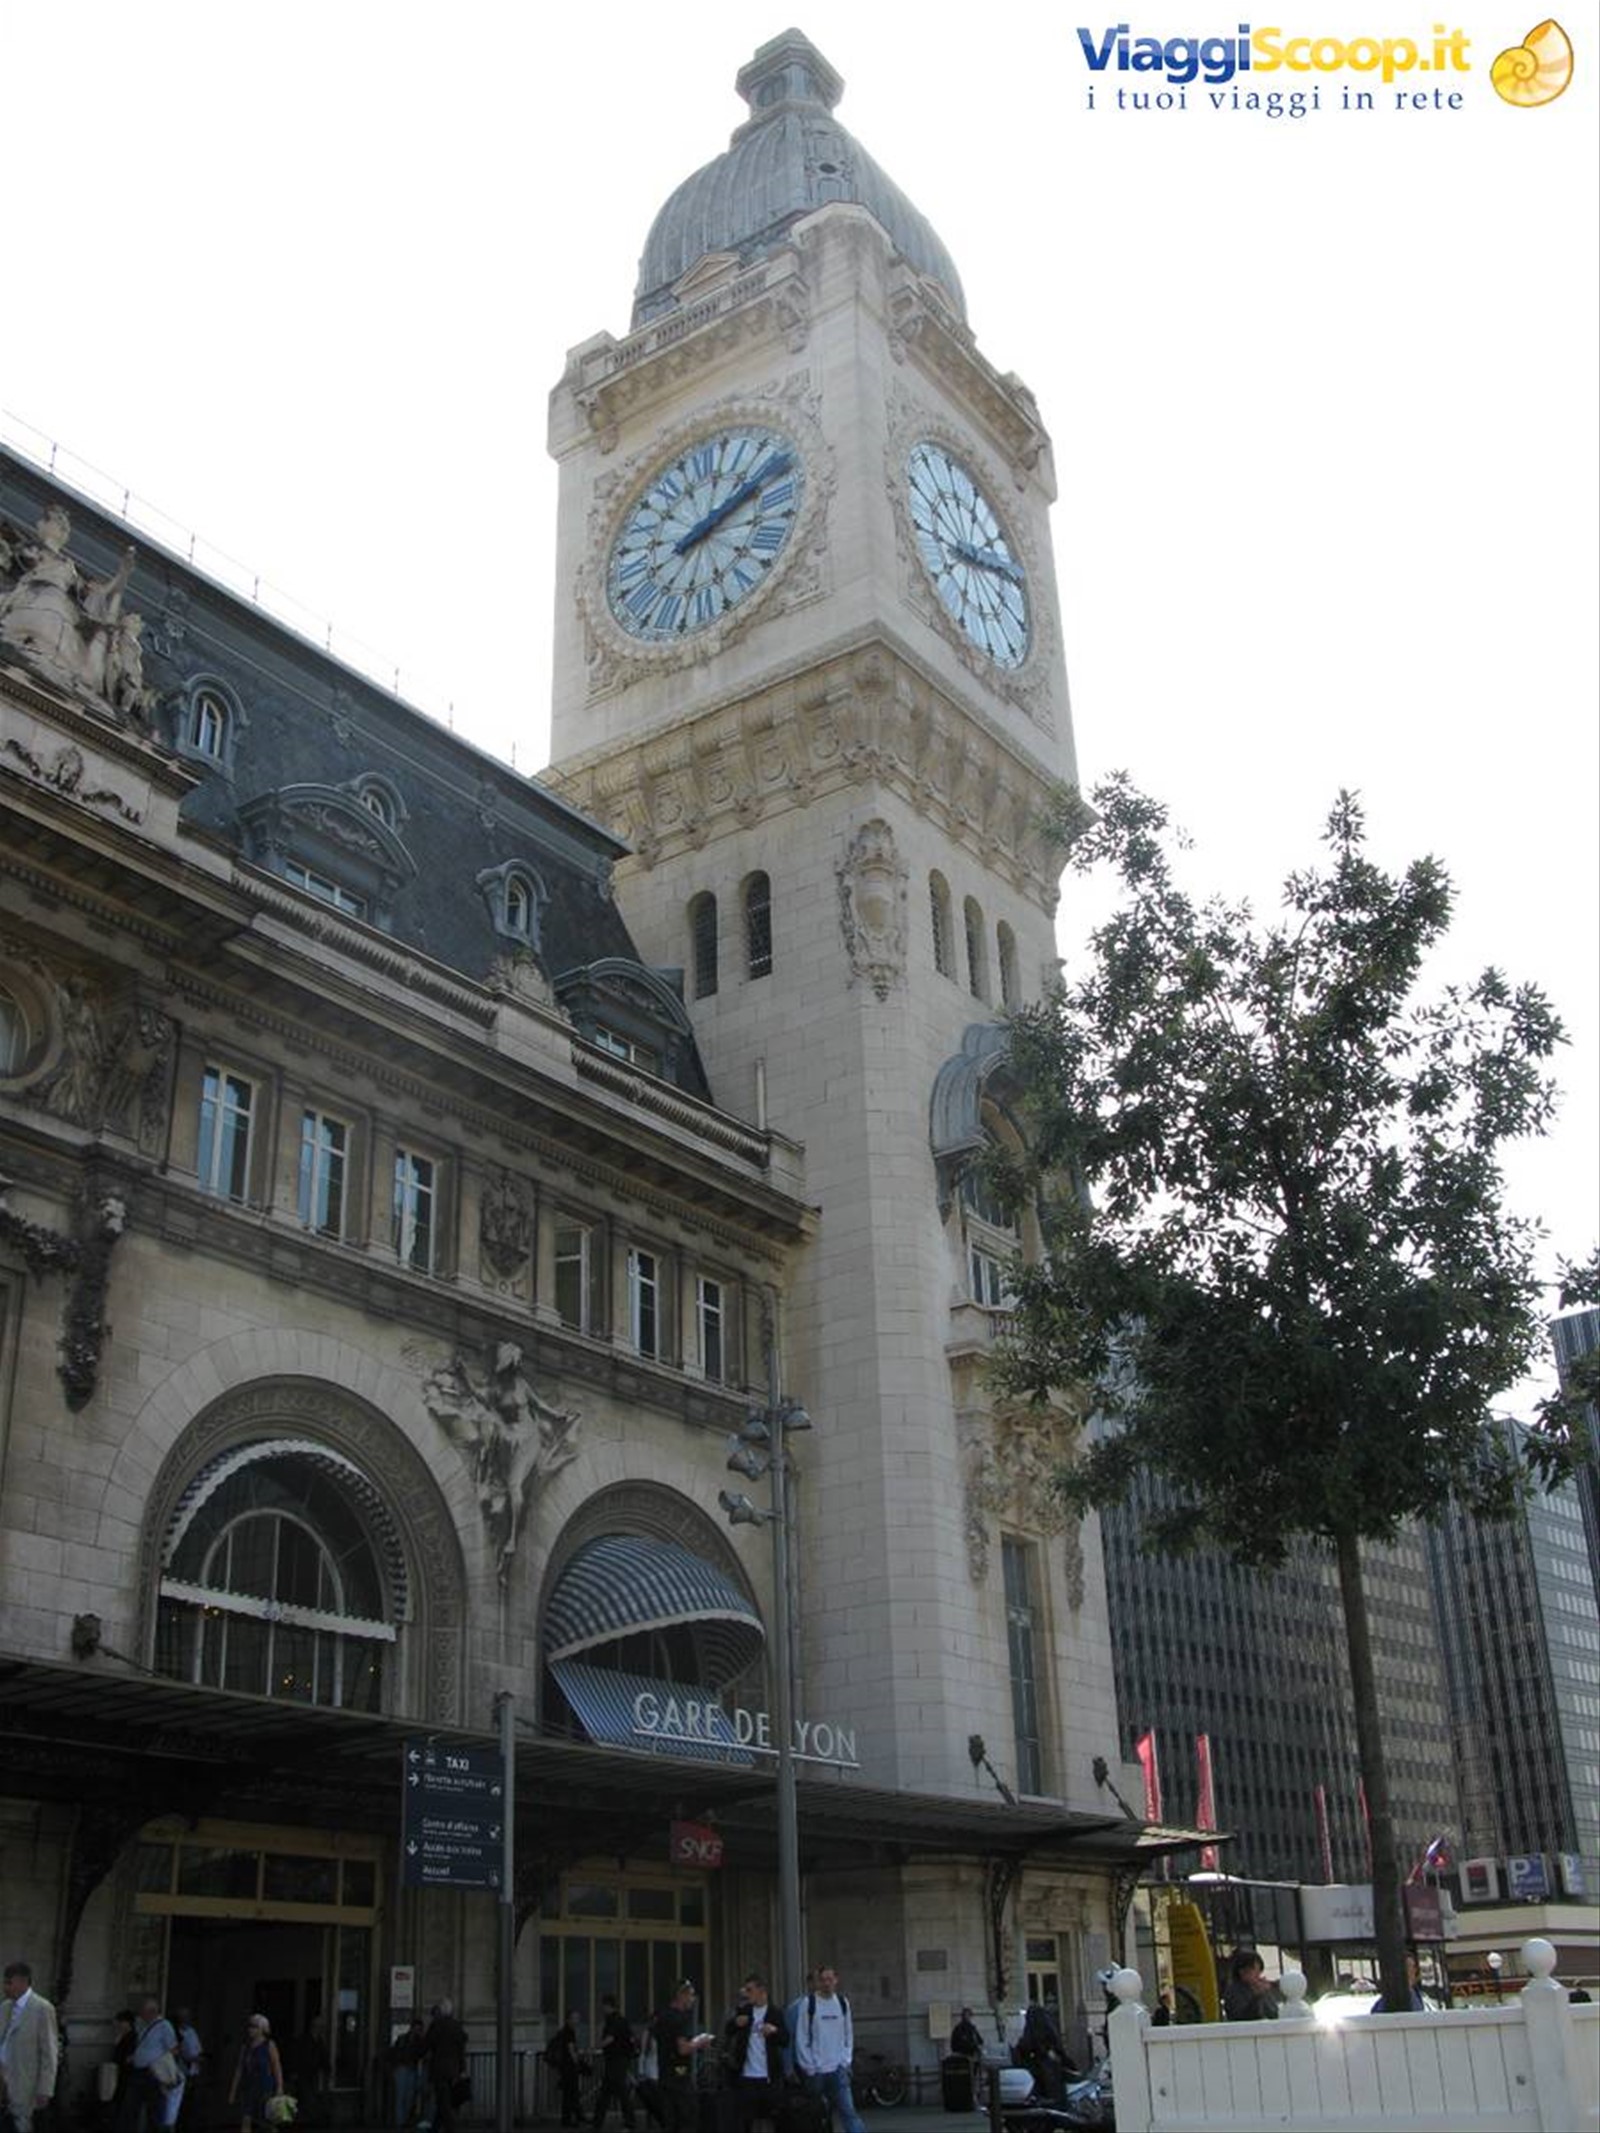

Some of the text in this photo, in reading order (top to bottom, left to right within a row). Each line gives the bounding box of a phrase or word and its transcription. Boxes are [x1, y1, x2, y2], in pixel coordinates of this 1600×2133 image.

[634, 1692, 857, 1762] GARE DE YON
[445, 1756, 470, 1771] TAXI
[678, 1836, 725, 1860] SNCF
[1510, 1860, 1531, 1883] P
